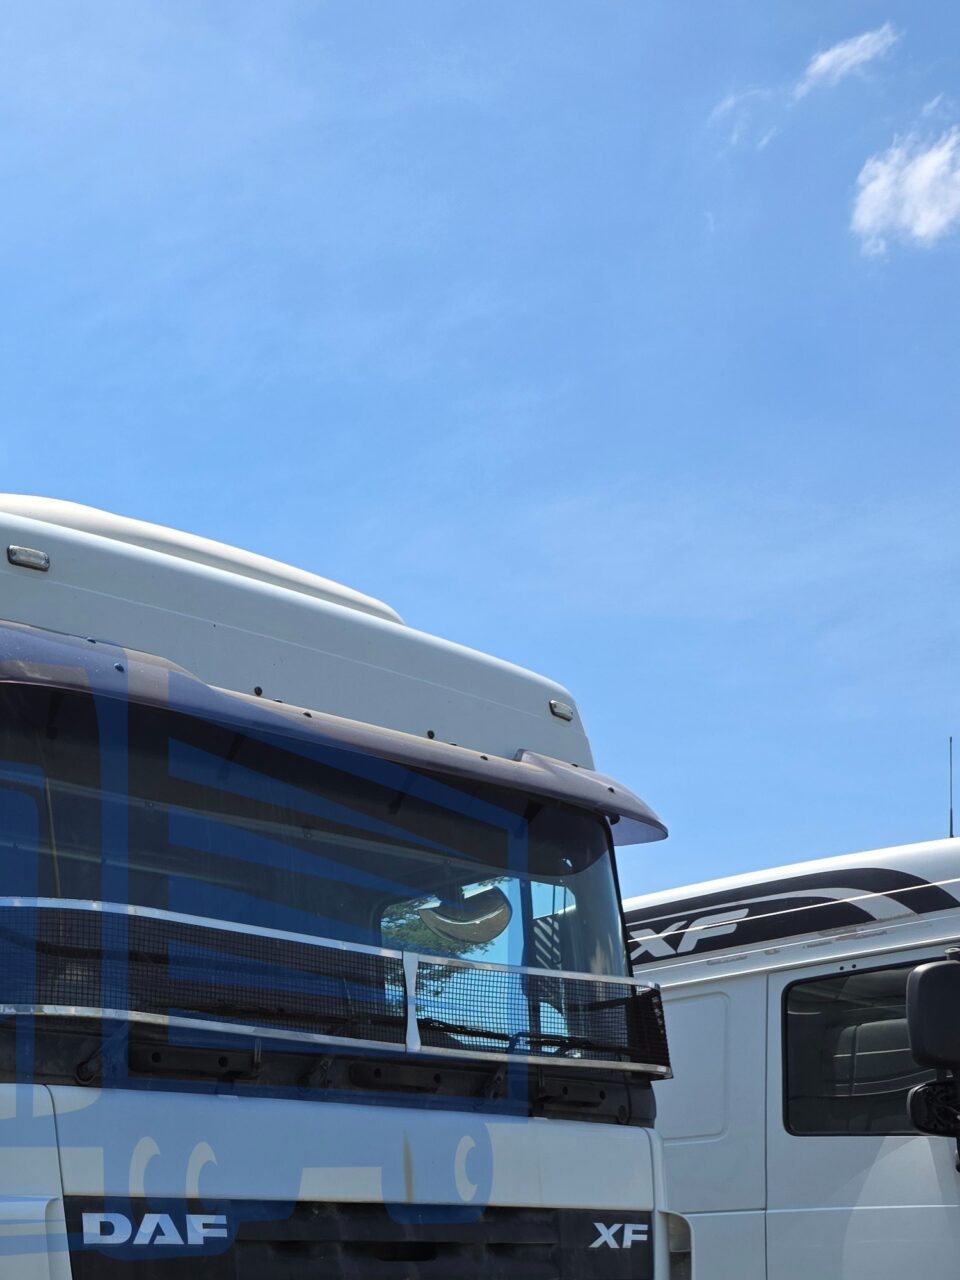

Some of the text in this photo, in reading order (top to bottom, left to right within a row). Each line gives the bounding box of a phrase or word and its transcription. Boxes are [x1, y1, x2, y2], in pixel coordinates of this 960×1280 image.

[629, 908, 749, 961] XF
[82, 1212, 228, 1246] DAF
[589, 1222, 649, 1250] XF
